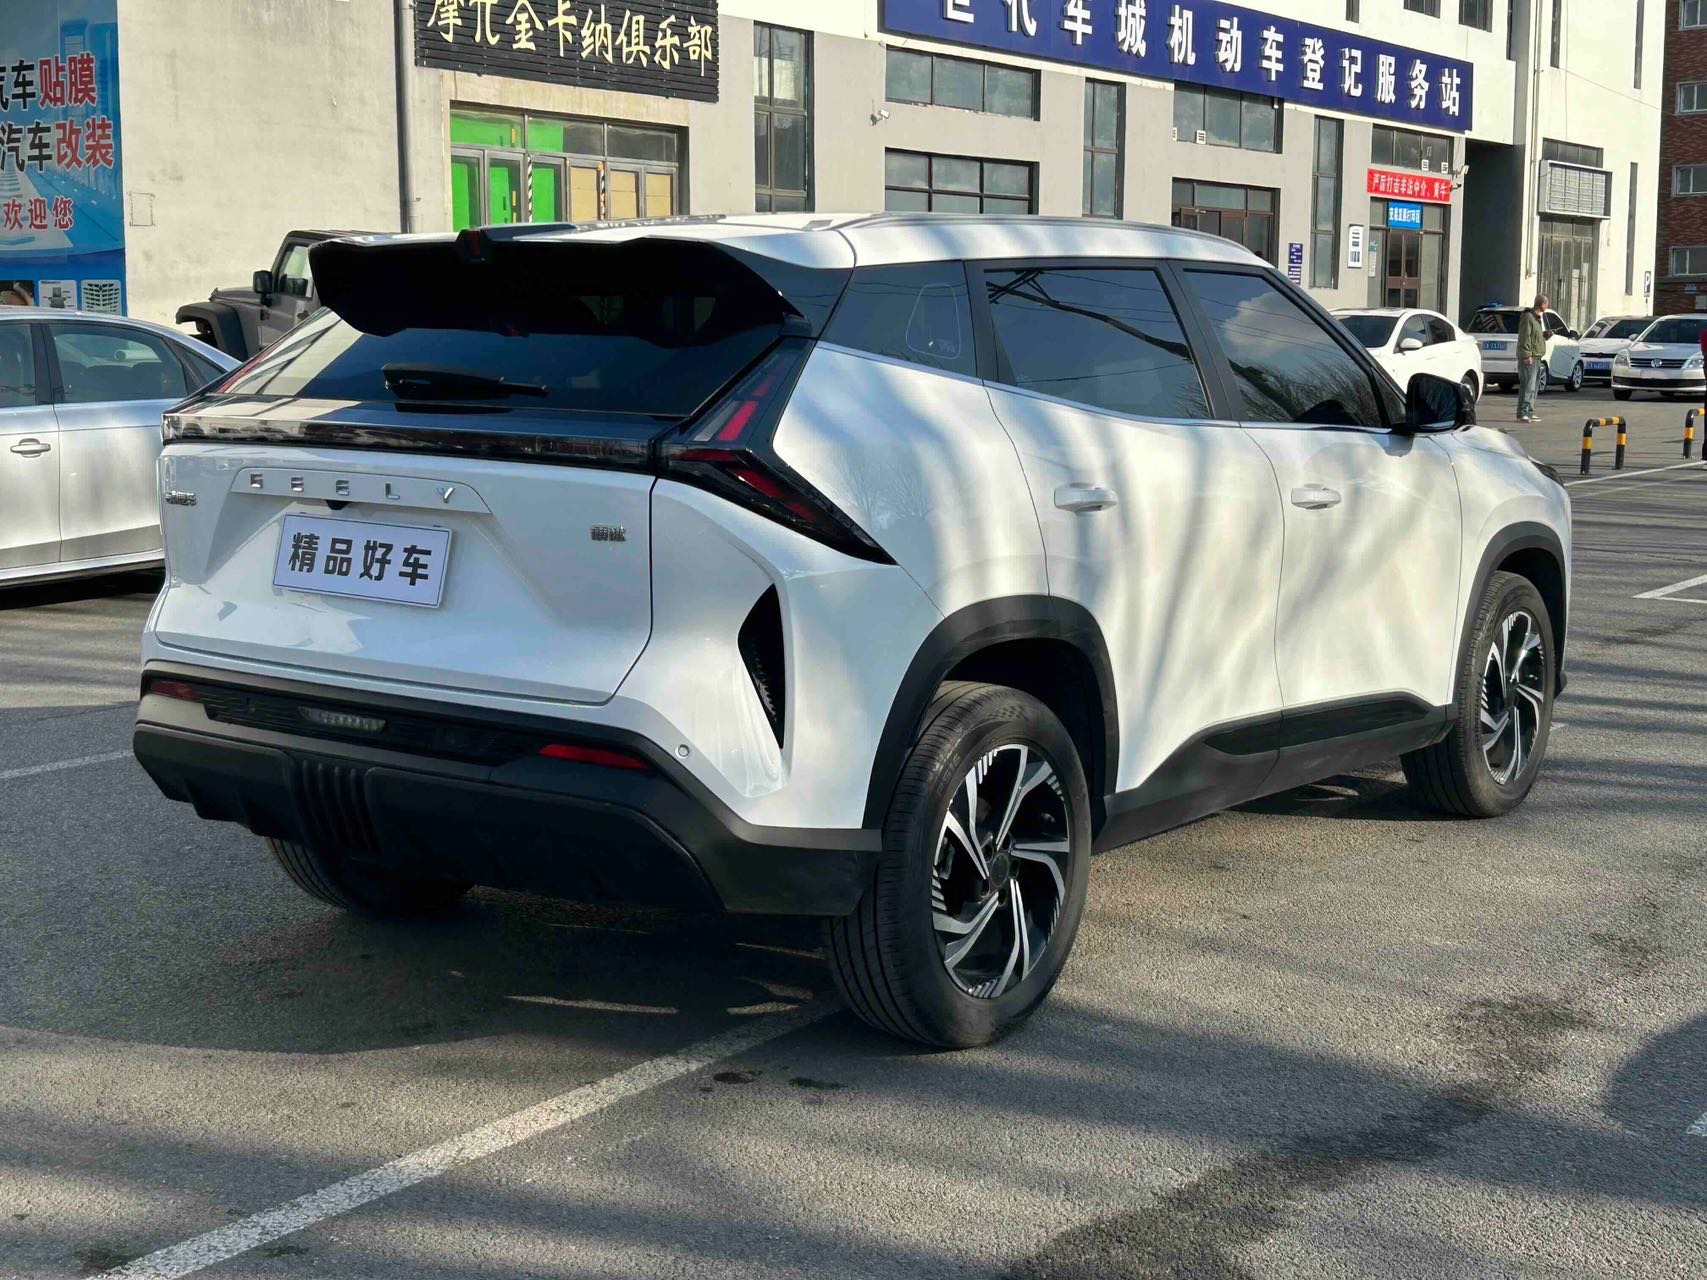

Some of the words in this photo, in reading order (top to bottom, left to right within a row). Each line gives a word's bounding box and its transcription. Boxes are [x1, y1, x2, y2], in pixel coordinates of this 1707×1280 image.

[0, 117, 114, 172] 汽车改装
[3, 197, 73, 231] 欢迎您
[288, 531, 432, 587] 精品好车
